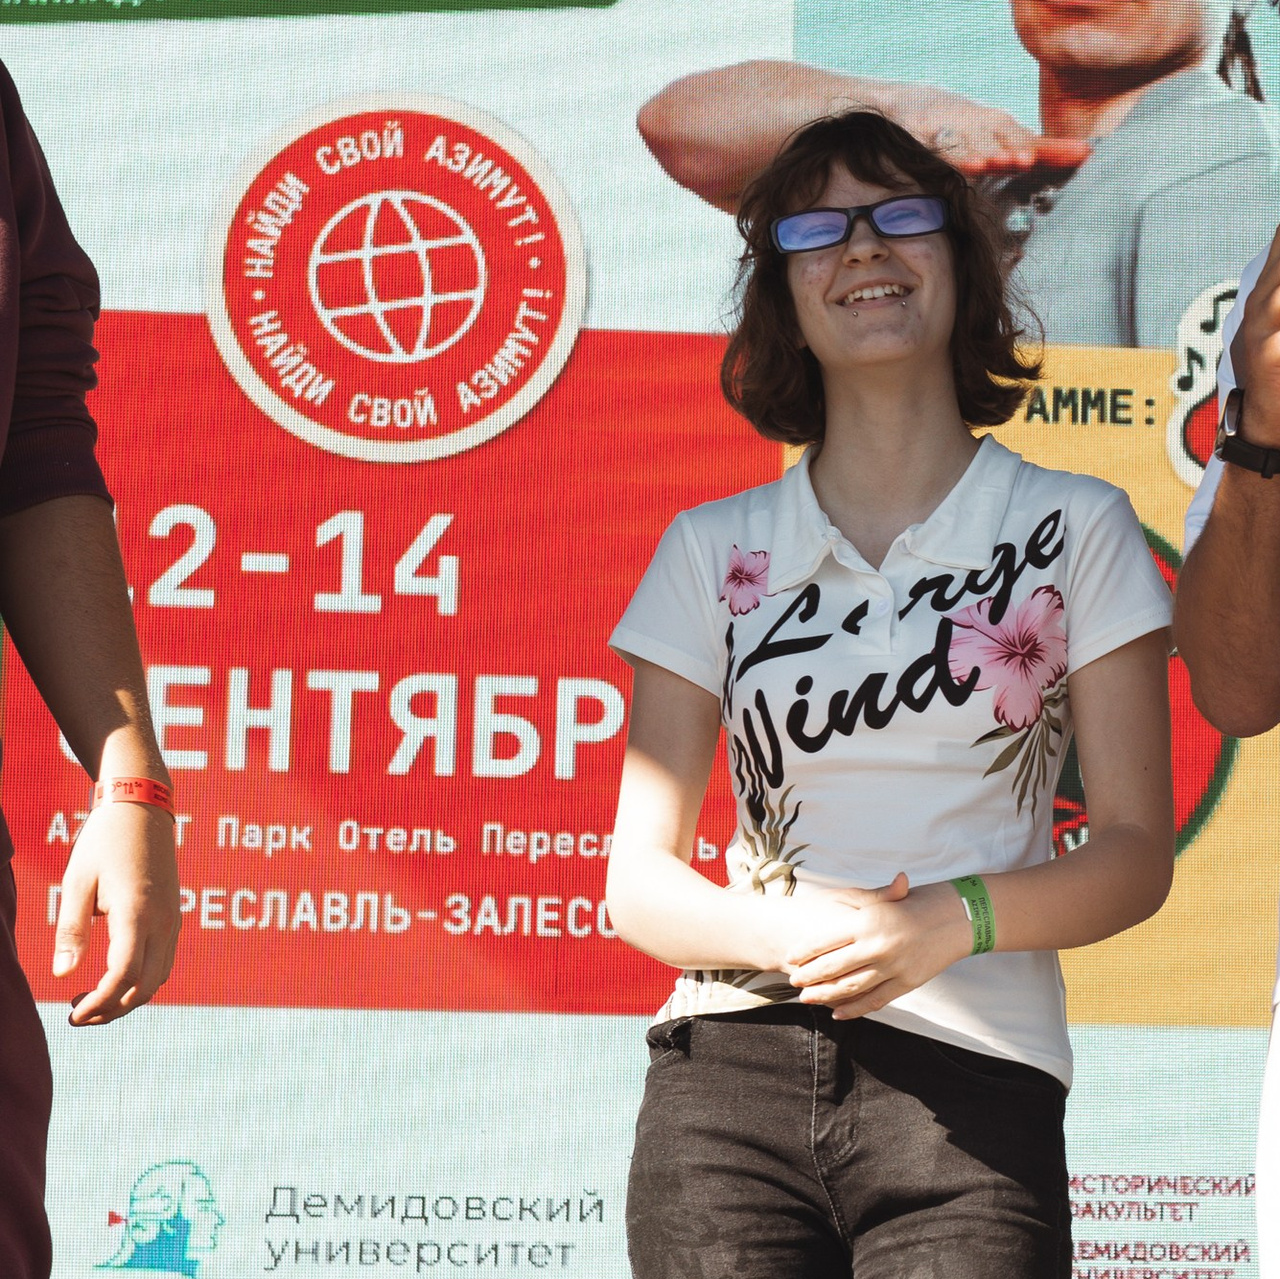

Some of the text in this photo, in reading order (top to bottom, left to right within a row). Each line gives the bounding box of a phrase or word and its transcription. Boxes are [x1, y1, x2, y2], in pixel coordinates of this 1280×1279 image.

[245, 121, 546, 278] НАЙДИ СВОЙ АЗИМУТ!
[249, 288, 553, 428] НАЙДИ СВОЙ АЗИМУТ!
[129, 503, 461, 617] 2-14
[59, 664, 627, 780] ЕНТЯБР
[217, 817, 313, 858] Парк
[338, 820, 457, 855] Отель
[265, 1186, 604, 1224] Демидовский
[262, 1236, 577, 1273] университет
[1072, 1239, 1251, 1263] ЕМИДОВСКИЙ
